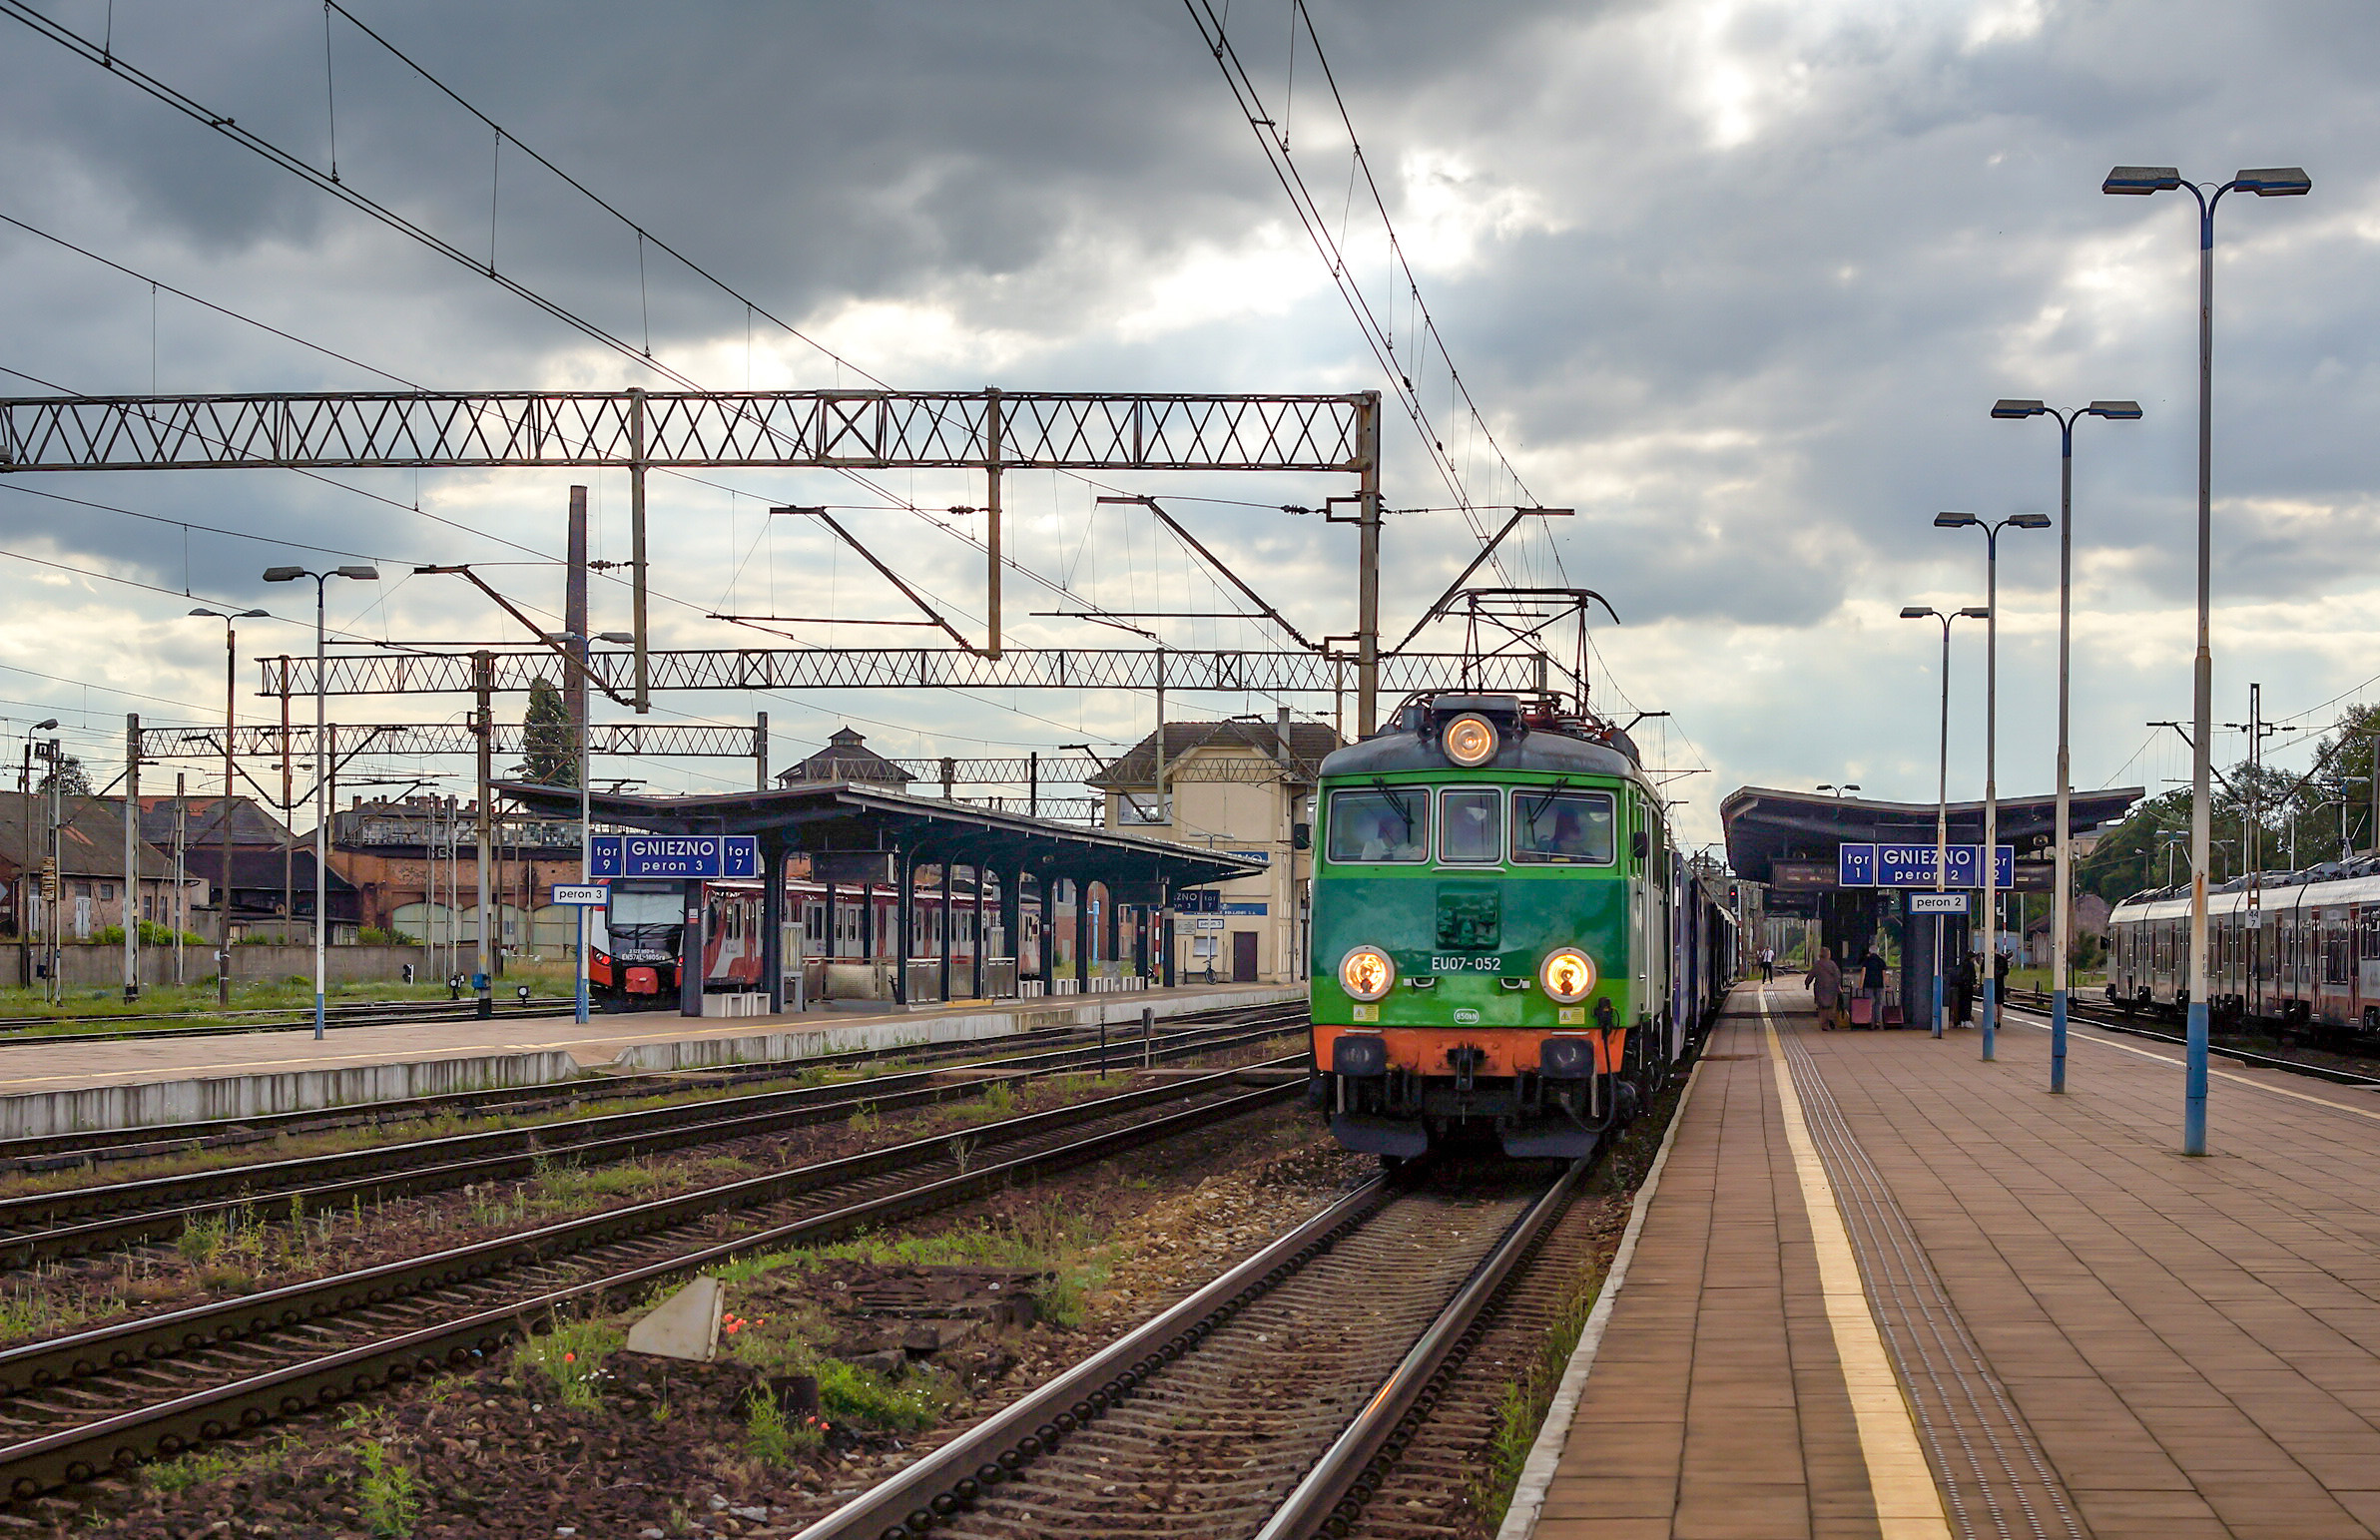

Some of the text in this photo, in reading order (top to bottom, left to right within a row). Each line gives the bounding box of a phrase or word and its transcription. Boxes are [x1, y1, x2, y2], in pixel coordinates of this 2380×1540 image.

[596, 845, 618, 856] tor
[631, 841, 715, 856] GNIEZNO
[728, 845, 750, 856] tor
[1847, 853, 1870, 865] tor
[1884, 849, 1971, 865] GNIEZNO
[1995, 857, 2008, 866] or
[602, 858, 611, 870] 9
[641, 859, 704, 873] peron 3
[735, 859, 743, 870] 7
[1856, 867, 1861, 878] 1
[1951, 869, 1959, 880] 2
[559, 889, 602, 900] peron 3
[1917, 896, 1962, 909] peron 2
[2248, 910, 2259, 919] 44
[1432, 956, 1501, 971] EU07-052
